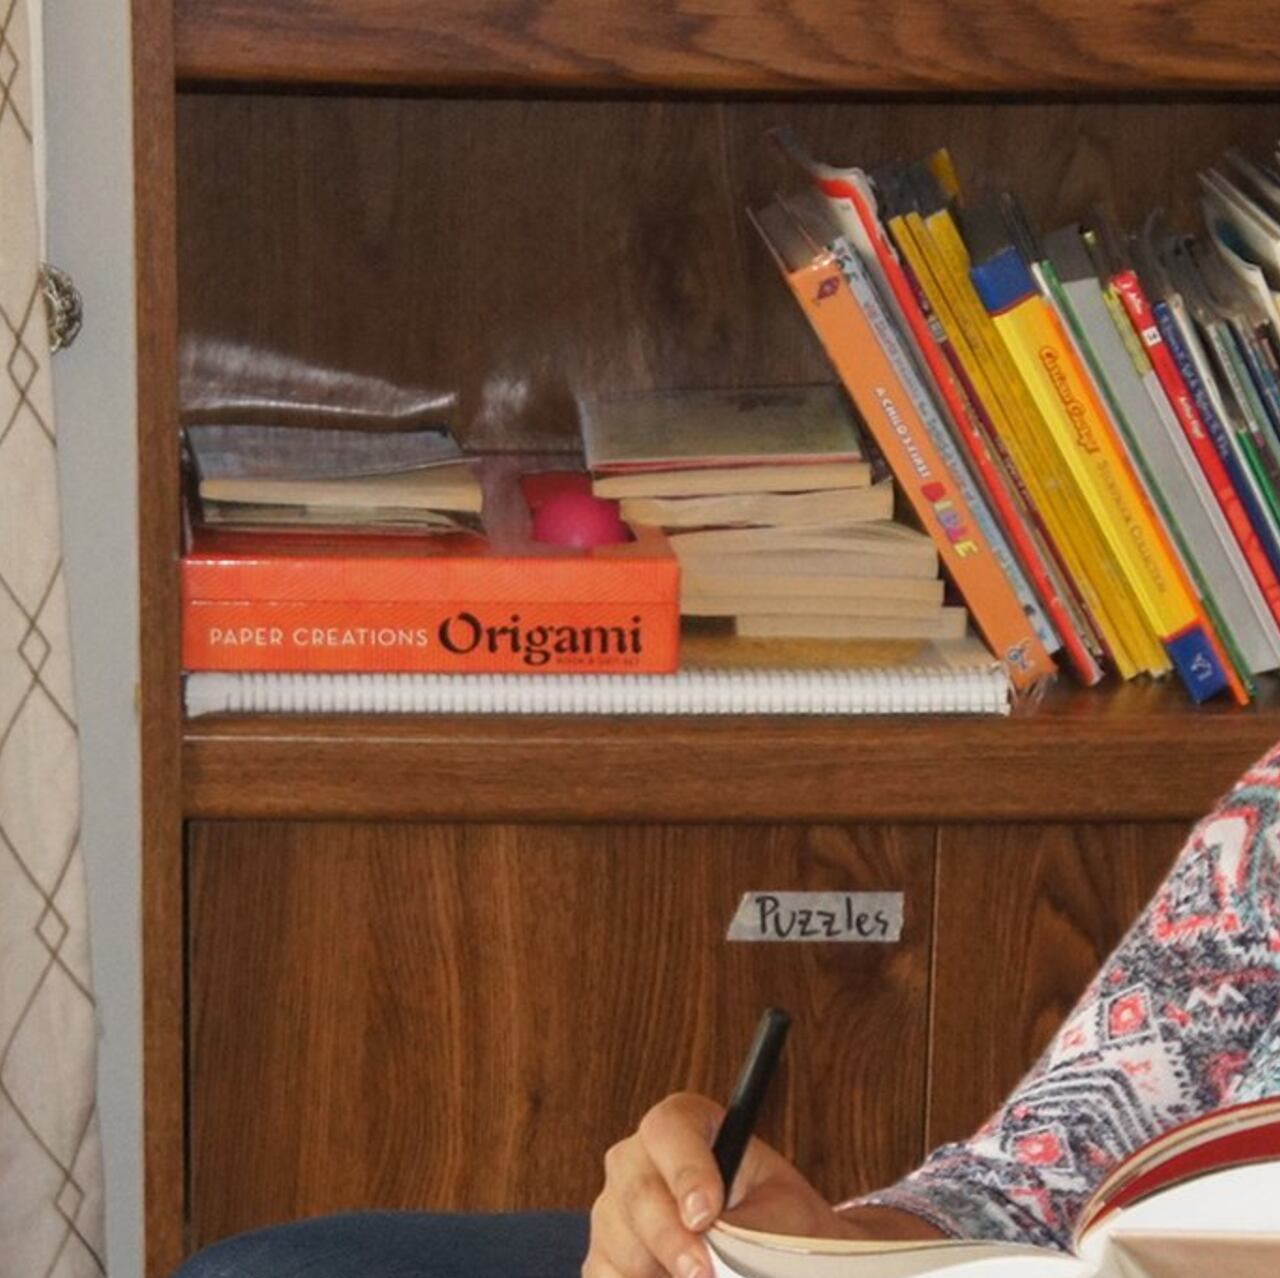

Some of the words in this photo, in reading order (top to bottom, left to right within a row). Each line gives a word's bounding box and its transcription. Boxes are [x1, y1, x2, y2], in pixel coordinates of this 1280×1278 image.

[209, 628, 283, 647] PAPER
[292, 627, 428, 647] CREATIONS
[438, 612, 643, 666] Origami
[755, 895, 890, 937] Puzzles
